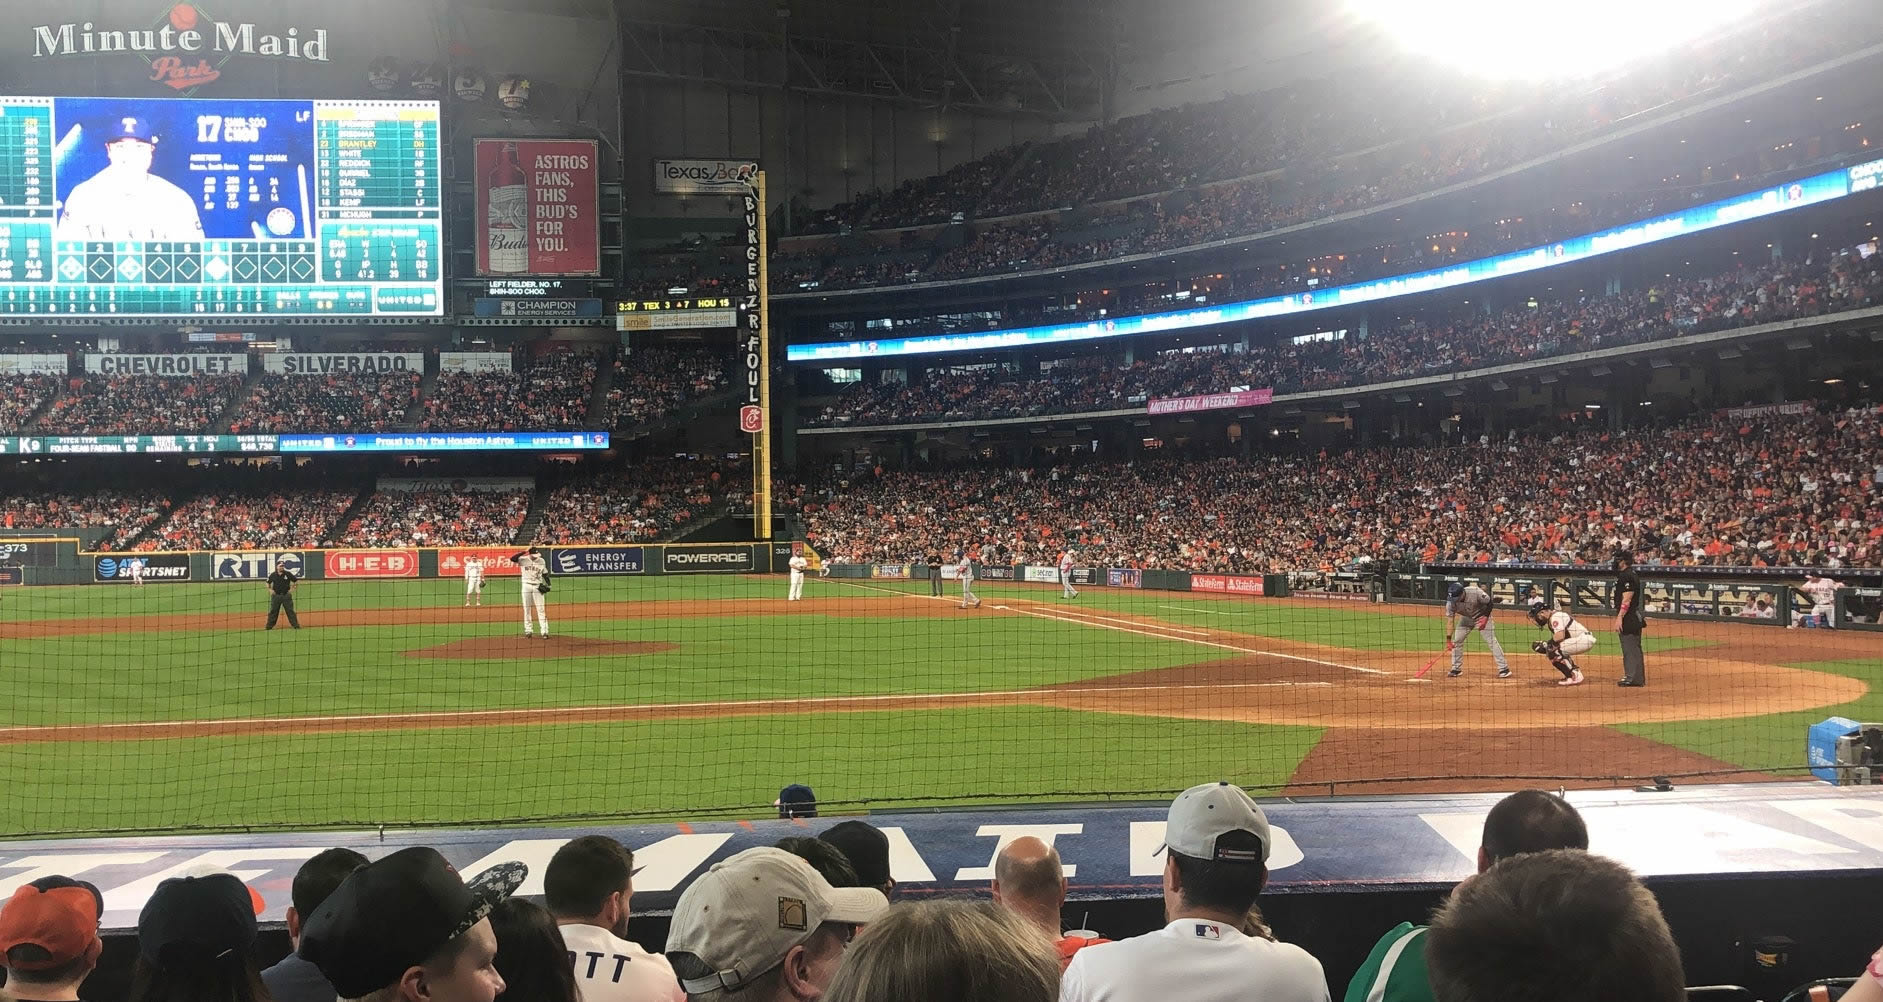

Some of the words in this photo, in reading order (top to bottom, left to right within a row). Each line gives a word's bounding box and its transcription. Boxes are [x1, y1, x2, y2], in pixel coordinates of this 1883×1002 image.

[32, 22, 201, 57] Minute
[213, 21, 330, 61] Maid
[149, 56, 220, 89] Park
[296, 110, 311, 122] LF
[197, 115, 222, 142] 17
[338, 140, 377, 148] BRANTLEY
[413, 140, 425, 148] DH
[535, 154, 589, 169] ASTROS
[660, 161, 709, 180] Texas
[535, 171, 574, 188] FANS,
[417, 189, 424, 197] C
[535, 188, 567, 203] THIS
[535, 204, 578, 219] BUD'S
[536, 221, 563, 235] FOR
[96, 243, 104, 253] 2
[154, 243, 163, 253] 4
[184, 243, 192, 253] 5
[241, 243, 249, 253] 7
[298, 243, 306, 253] 9
[361, 240, 370, 248] W
[391, 240, 397, 248] L
[536, 237, 569, 252] YOU.
[361, 260, 371, 269] IP
[390, 260, 398, 269] H
[378, 295, 423, 304] UNITED
[517, 301, 577, 310] CHAMPION
[618, 302, 637, 311] 3:37
[643, 301, 660, 310] TEX
[664, 301, 671, 309] 3
[683, 300, 690, 309] 7
[697, 299, 717, 308] HOU
[215, 302, 225, 313] 17
[625, 316, 649, 327] smile
[100, 356, 233, 374] CHEVROLET
[284, 355, 407, 373] SILVERADO
[746, 335, 759, 404] FOUL
[1149, 400, 1182, 413] MOTHER'S
[1201, 394, 1239, 408] WEEKEND
[20, 437, 31, 453] K
[188, 443, 195, 451] 4
[208, 443, 214, 451] 3
[283, 439, 321, 447] UNITED
[375, 437, 403, 446] Proud
[404, 438, 414, 446] to
[416, 437, 428, 447] fly
[430, 437, 445, 446] the
[447, 436, 485, 445] Houston
[486, 436, 515, 445] Astros
[532, 437, 571, 445] UNITED
[4, 543, 28, 552] 373
[338, 556, 405, 571] H-E-B
[585, 553, 627, 562] ENERGY
[667, 553, 748, 564] POWERADE
[119, 566, 187, 577] SPRTSNET
[586, 562, 637, 571] TRANSFER
